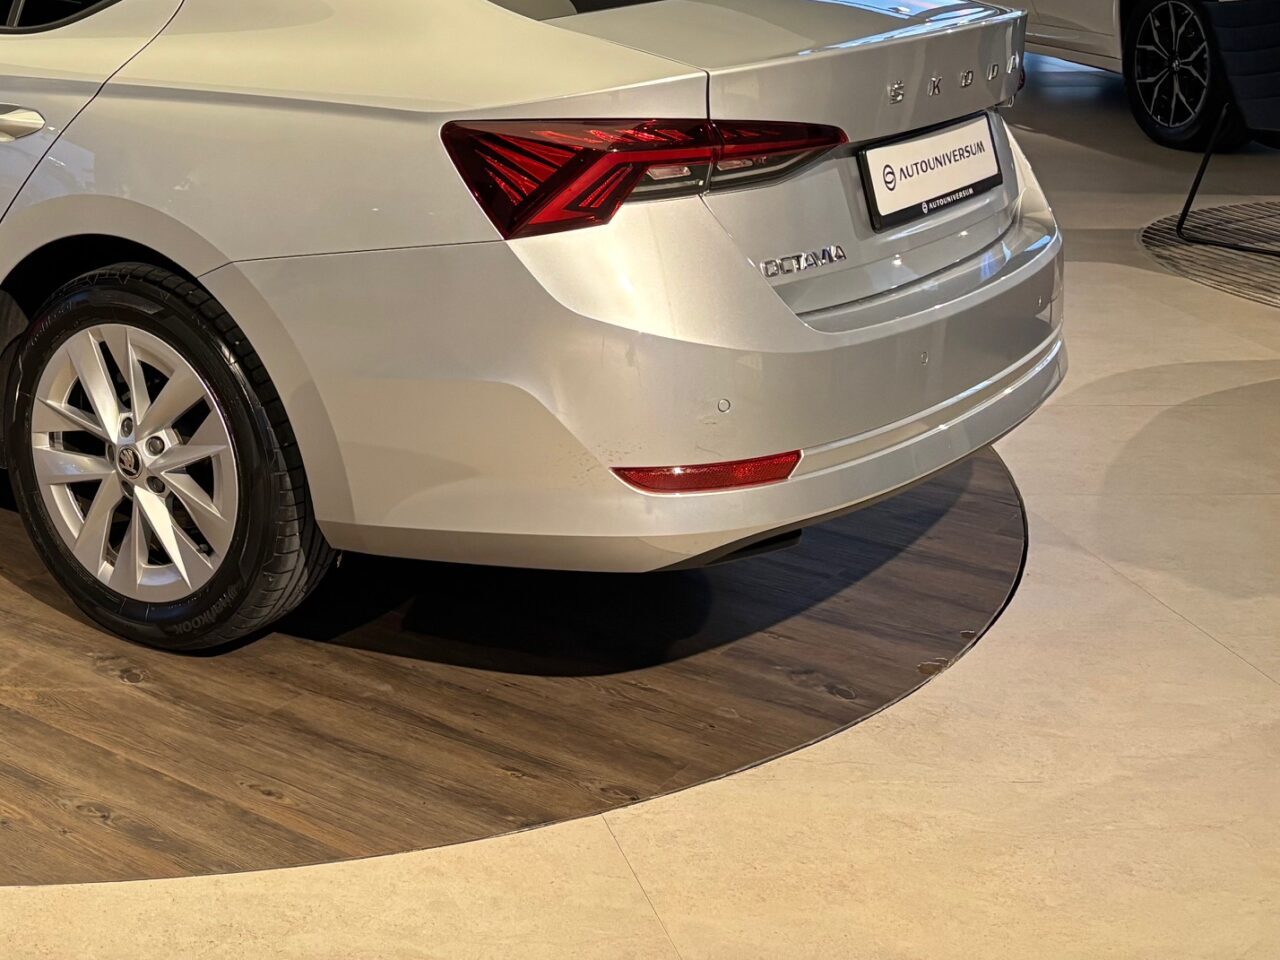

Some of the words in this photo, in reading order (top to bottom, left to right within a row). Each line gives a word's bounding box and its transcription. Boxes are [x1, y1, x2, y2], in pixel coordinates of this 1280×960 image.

[899, 140, 986, 182] AUTOUNIVERSUM
[928, 187, 974, 210] AUTOUNIVERSUM
[760, 245, 847, 278] OCTAVIA
